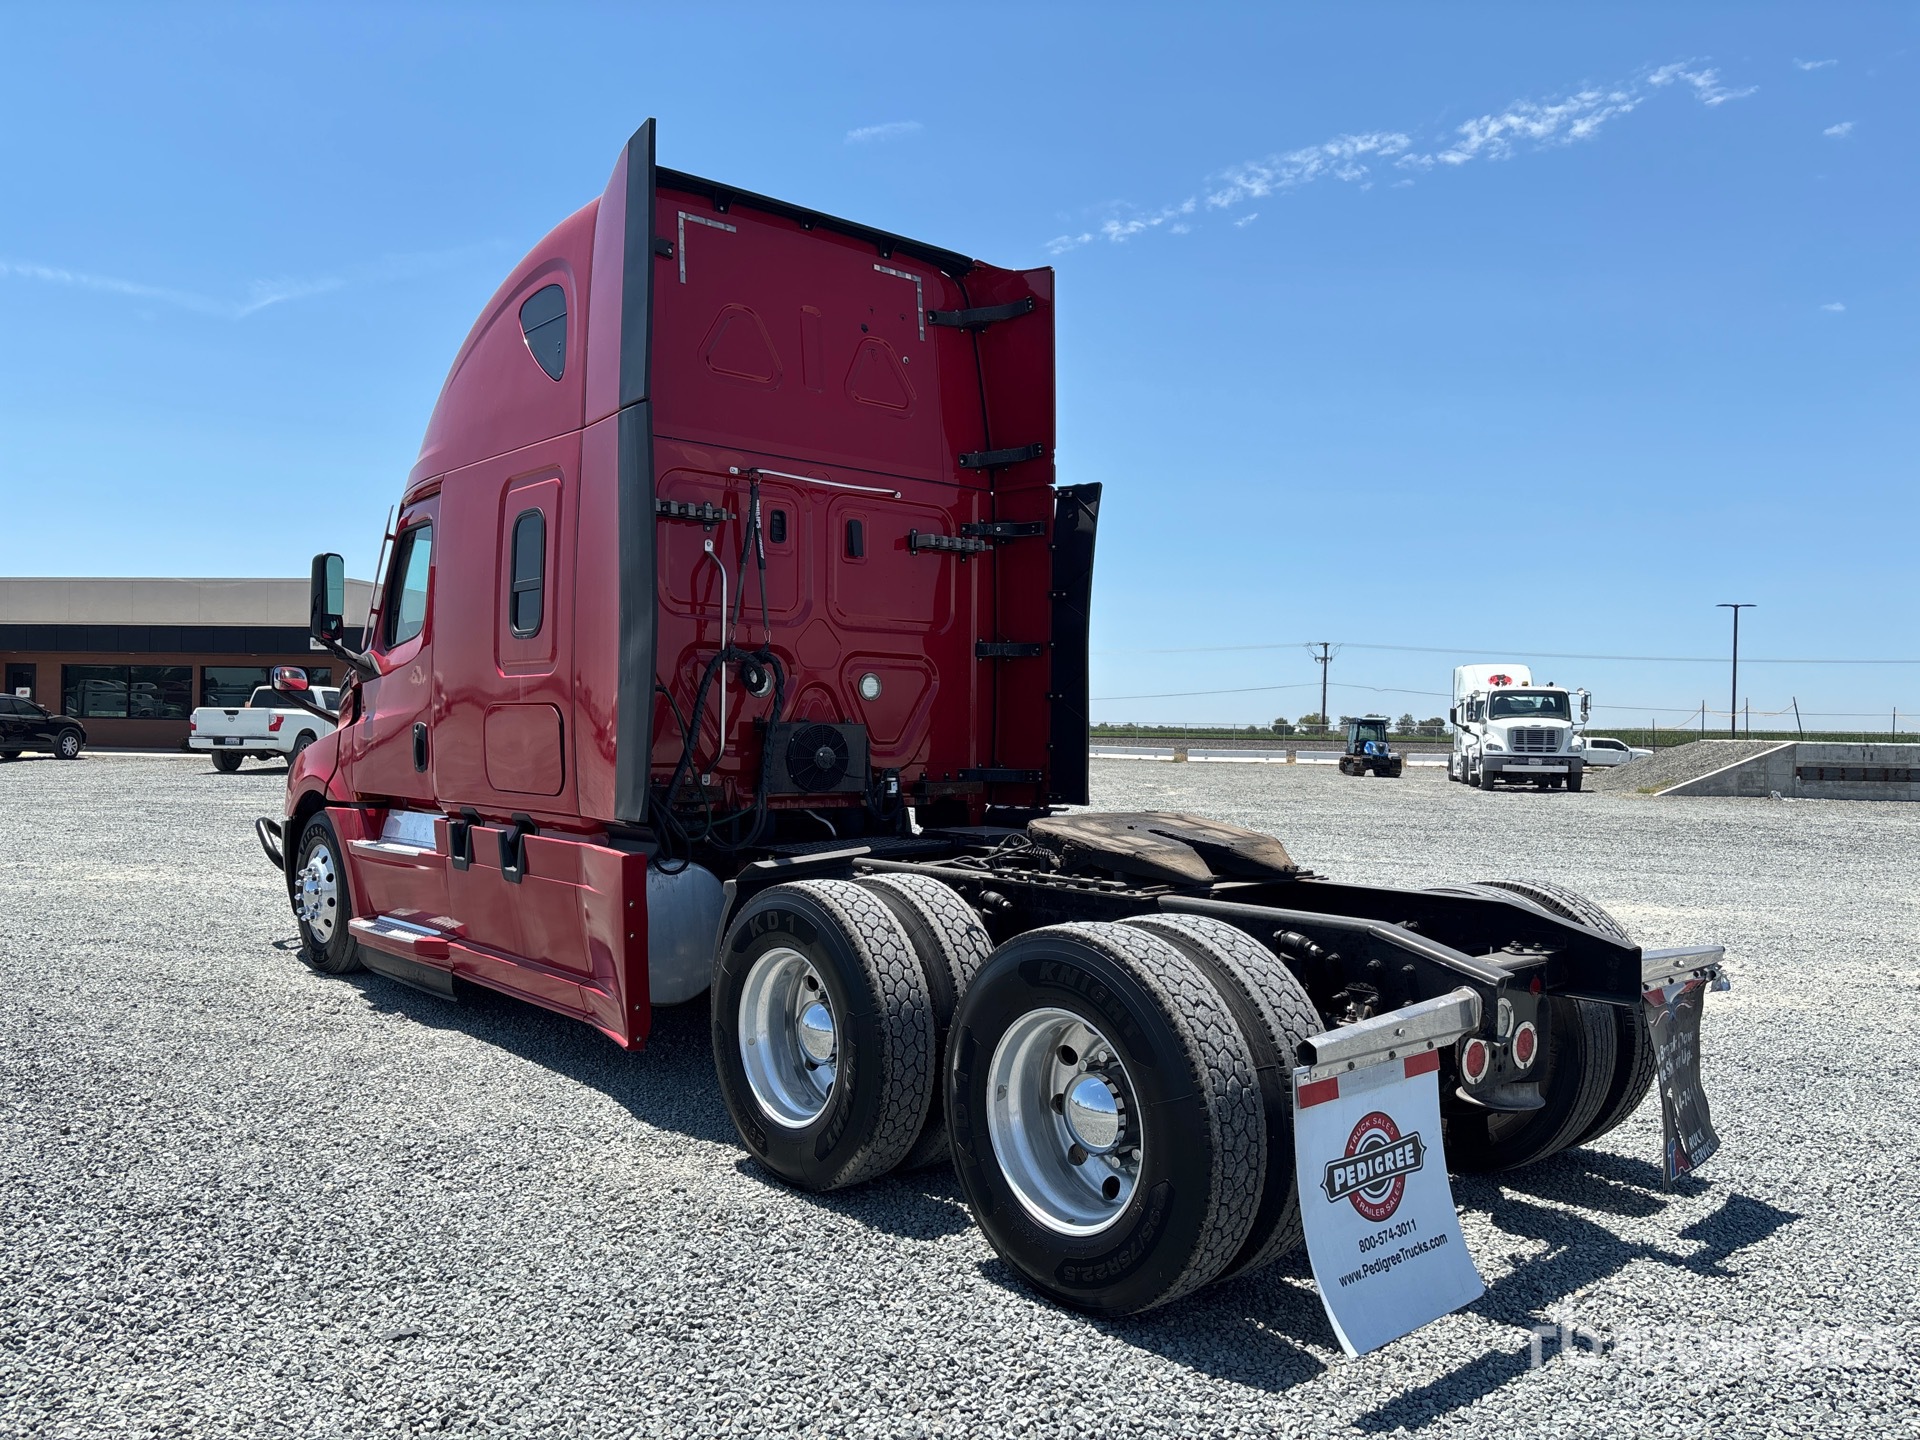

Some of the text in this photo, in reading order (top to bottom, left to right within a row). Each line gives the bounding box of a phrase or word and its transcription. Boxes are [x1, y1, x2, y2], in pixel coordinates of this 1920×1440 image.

[749, 911, 795, 938] KD1
[1039, 960, 1143, 1042] KNIGHT
[1348, 1118, 1394, 1150] TRUCK SALES
[1688, 1128, 1704, 1150] RUCK
[1333, 1142, 1415, 1192] PEDIGREE
[1668, 1137, 1692, 1182] TA
[1356, 1182, 1402, 1216] TRAILER SALES
[1358, 1218, 1417, 1253] 800-574-3011
[1338, 1233, 1448, 1288] www.PedigreeTrucks.com
